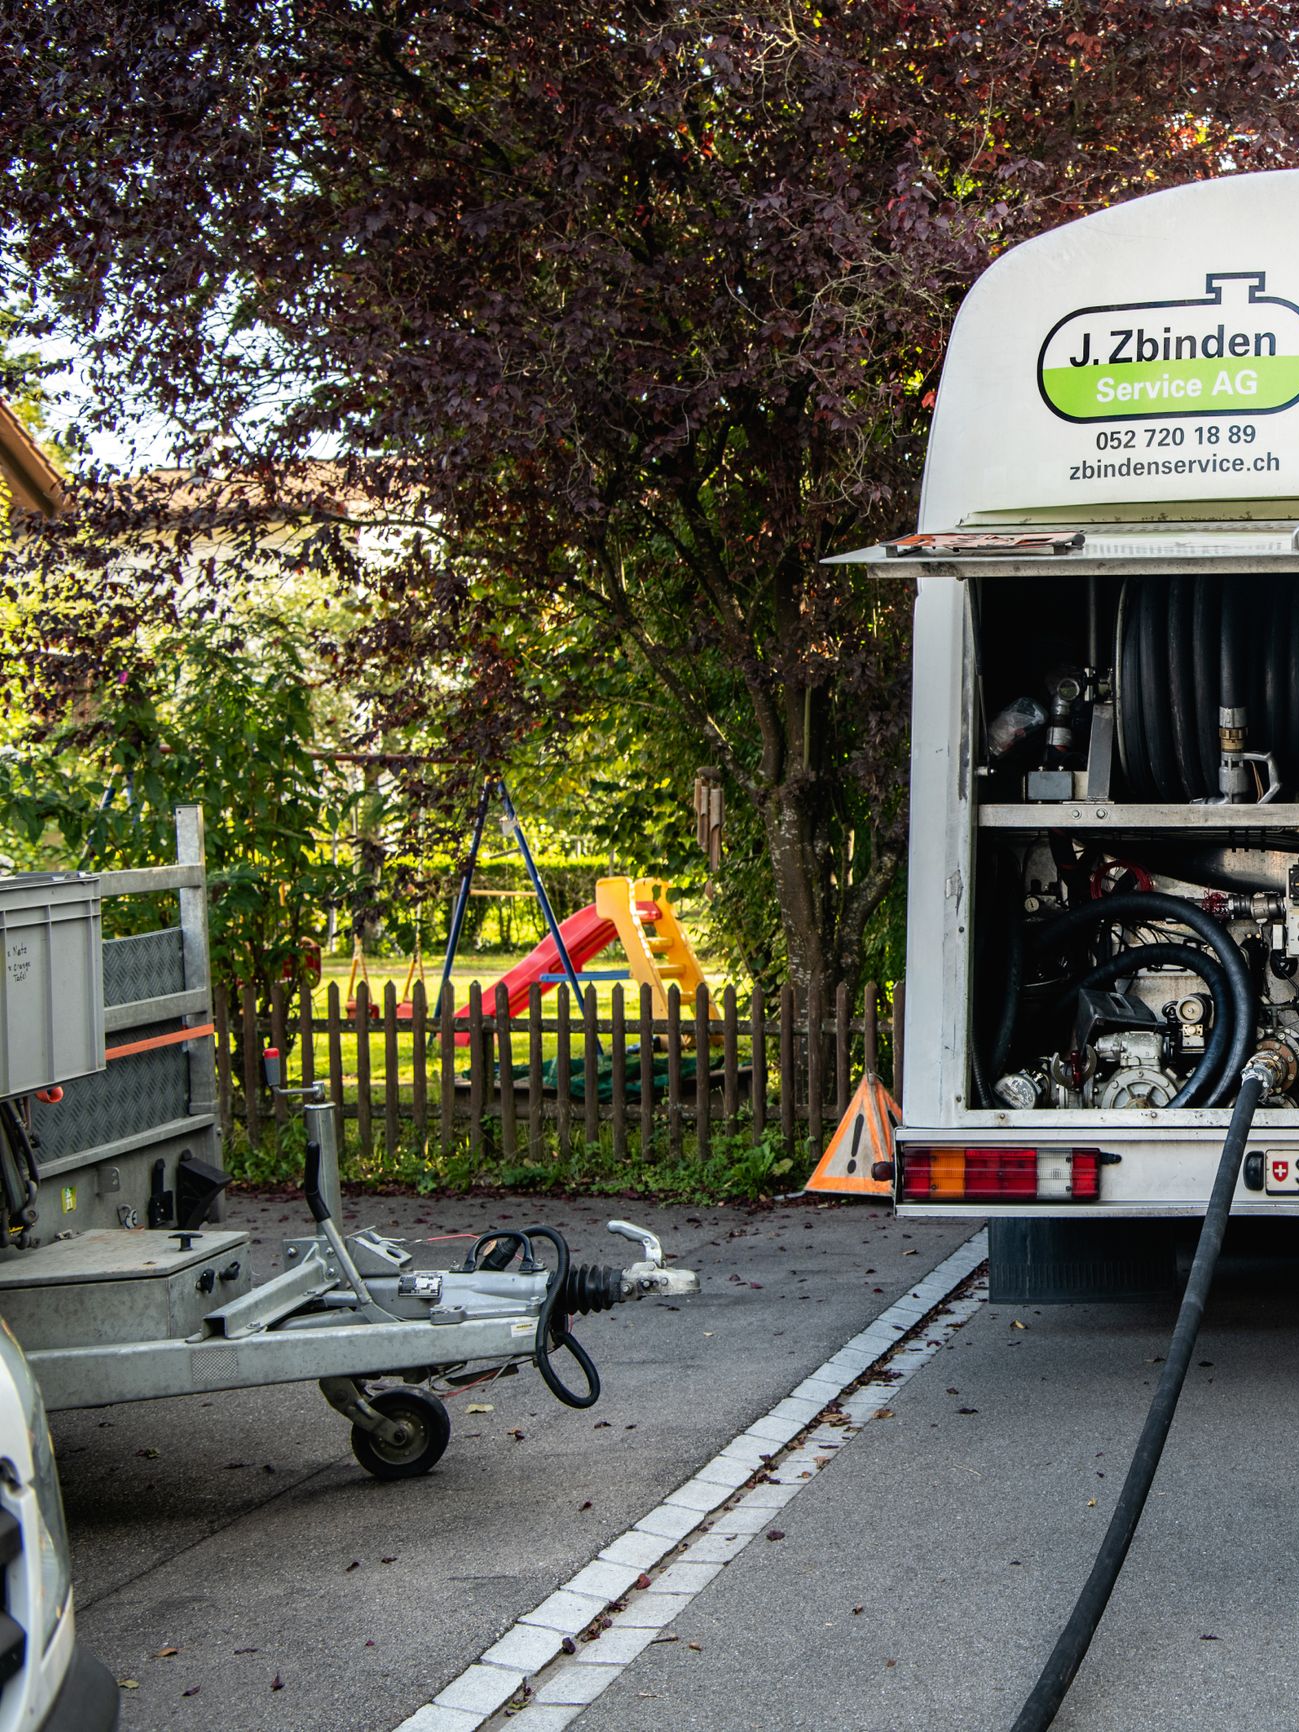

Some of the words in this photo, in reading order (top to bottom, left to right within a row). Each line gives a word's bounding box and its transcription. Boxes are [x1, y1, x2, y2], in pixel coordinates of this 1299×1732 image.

[1108, 324, 1277, 364] Zbinden
[1096, 373, 1203, 403] Service
[1211, 369, 1259, 396] AG
[1096, 430, 1137, 451] 052
[1143, 427, 1186, 449] 720
[1194, 426, 1221, 446] 18
[1227, 424, 1257, 444] 89
[1069, 451, 1281, 481] zbindenservice.ch
